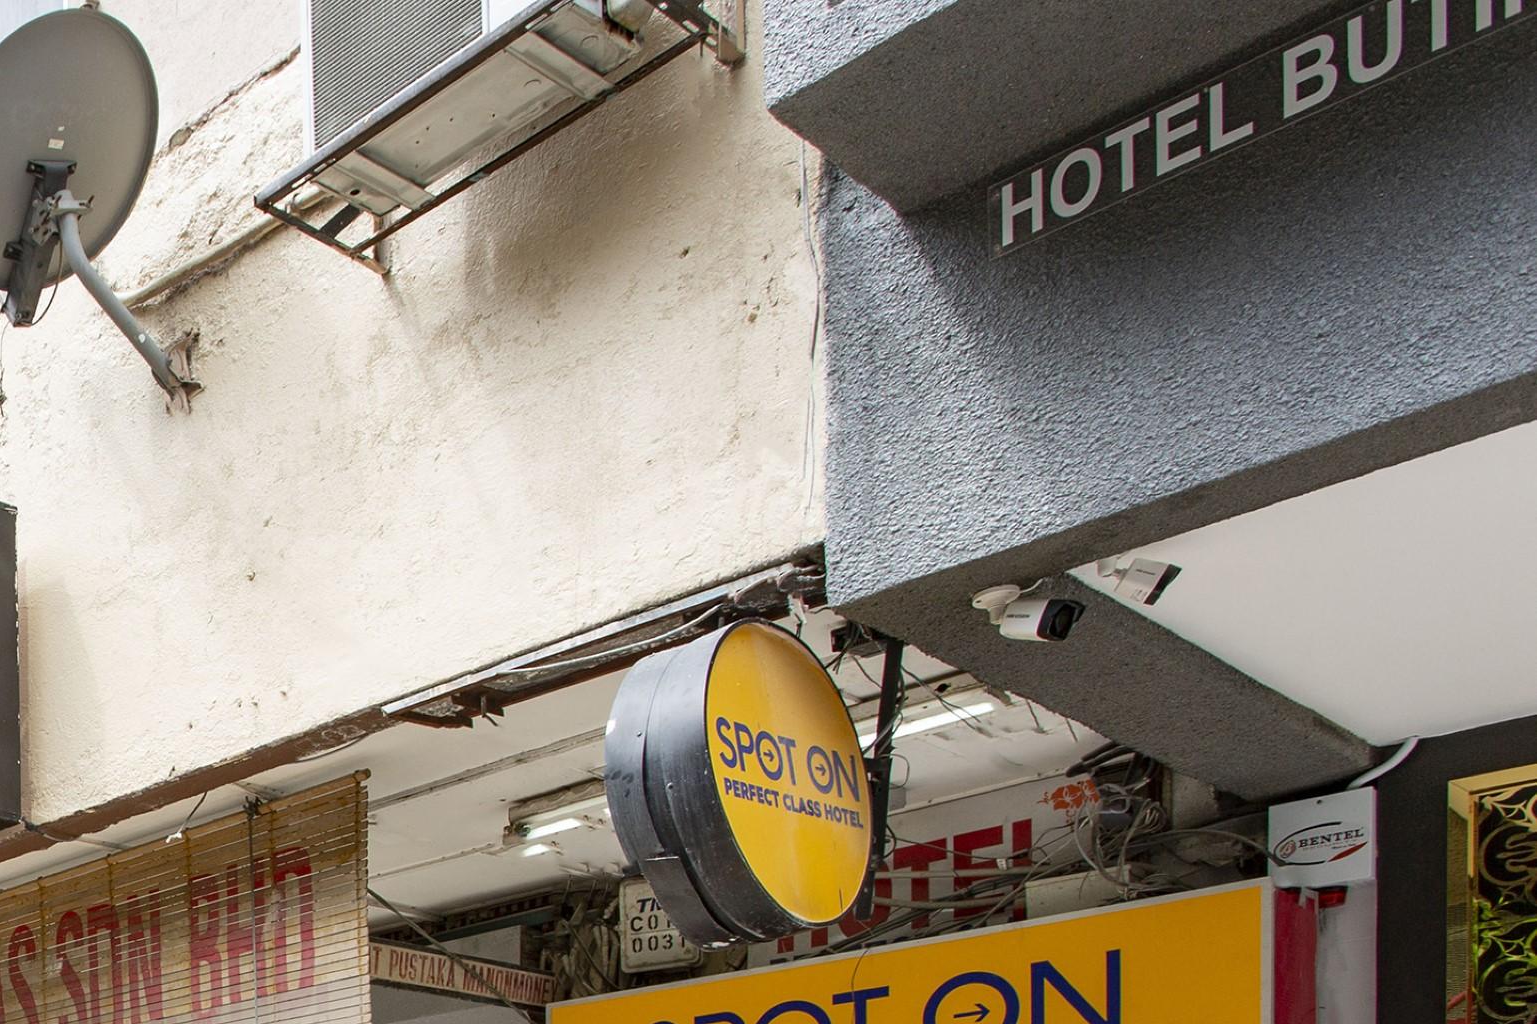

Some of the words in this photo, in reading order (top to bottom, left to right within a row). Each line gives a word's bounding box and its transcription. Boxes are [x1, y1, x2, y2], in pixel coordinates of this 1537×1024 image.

[1001, 82, 1254, 247] HOTEL
[1283, 0, 1527, 118] BUT
[715, 716, 797, 787] SPOT
[806, 745, 861, 802] ON
[723, 777, 780, 809] PERFECT
[782, 793, 822, 818] CLASS
[824, 803, 864, 830] HOTEL
[1298, 829, 1365, 848] BENTEL
[389, 949, 455, 989] PUSTAKA
